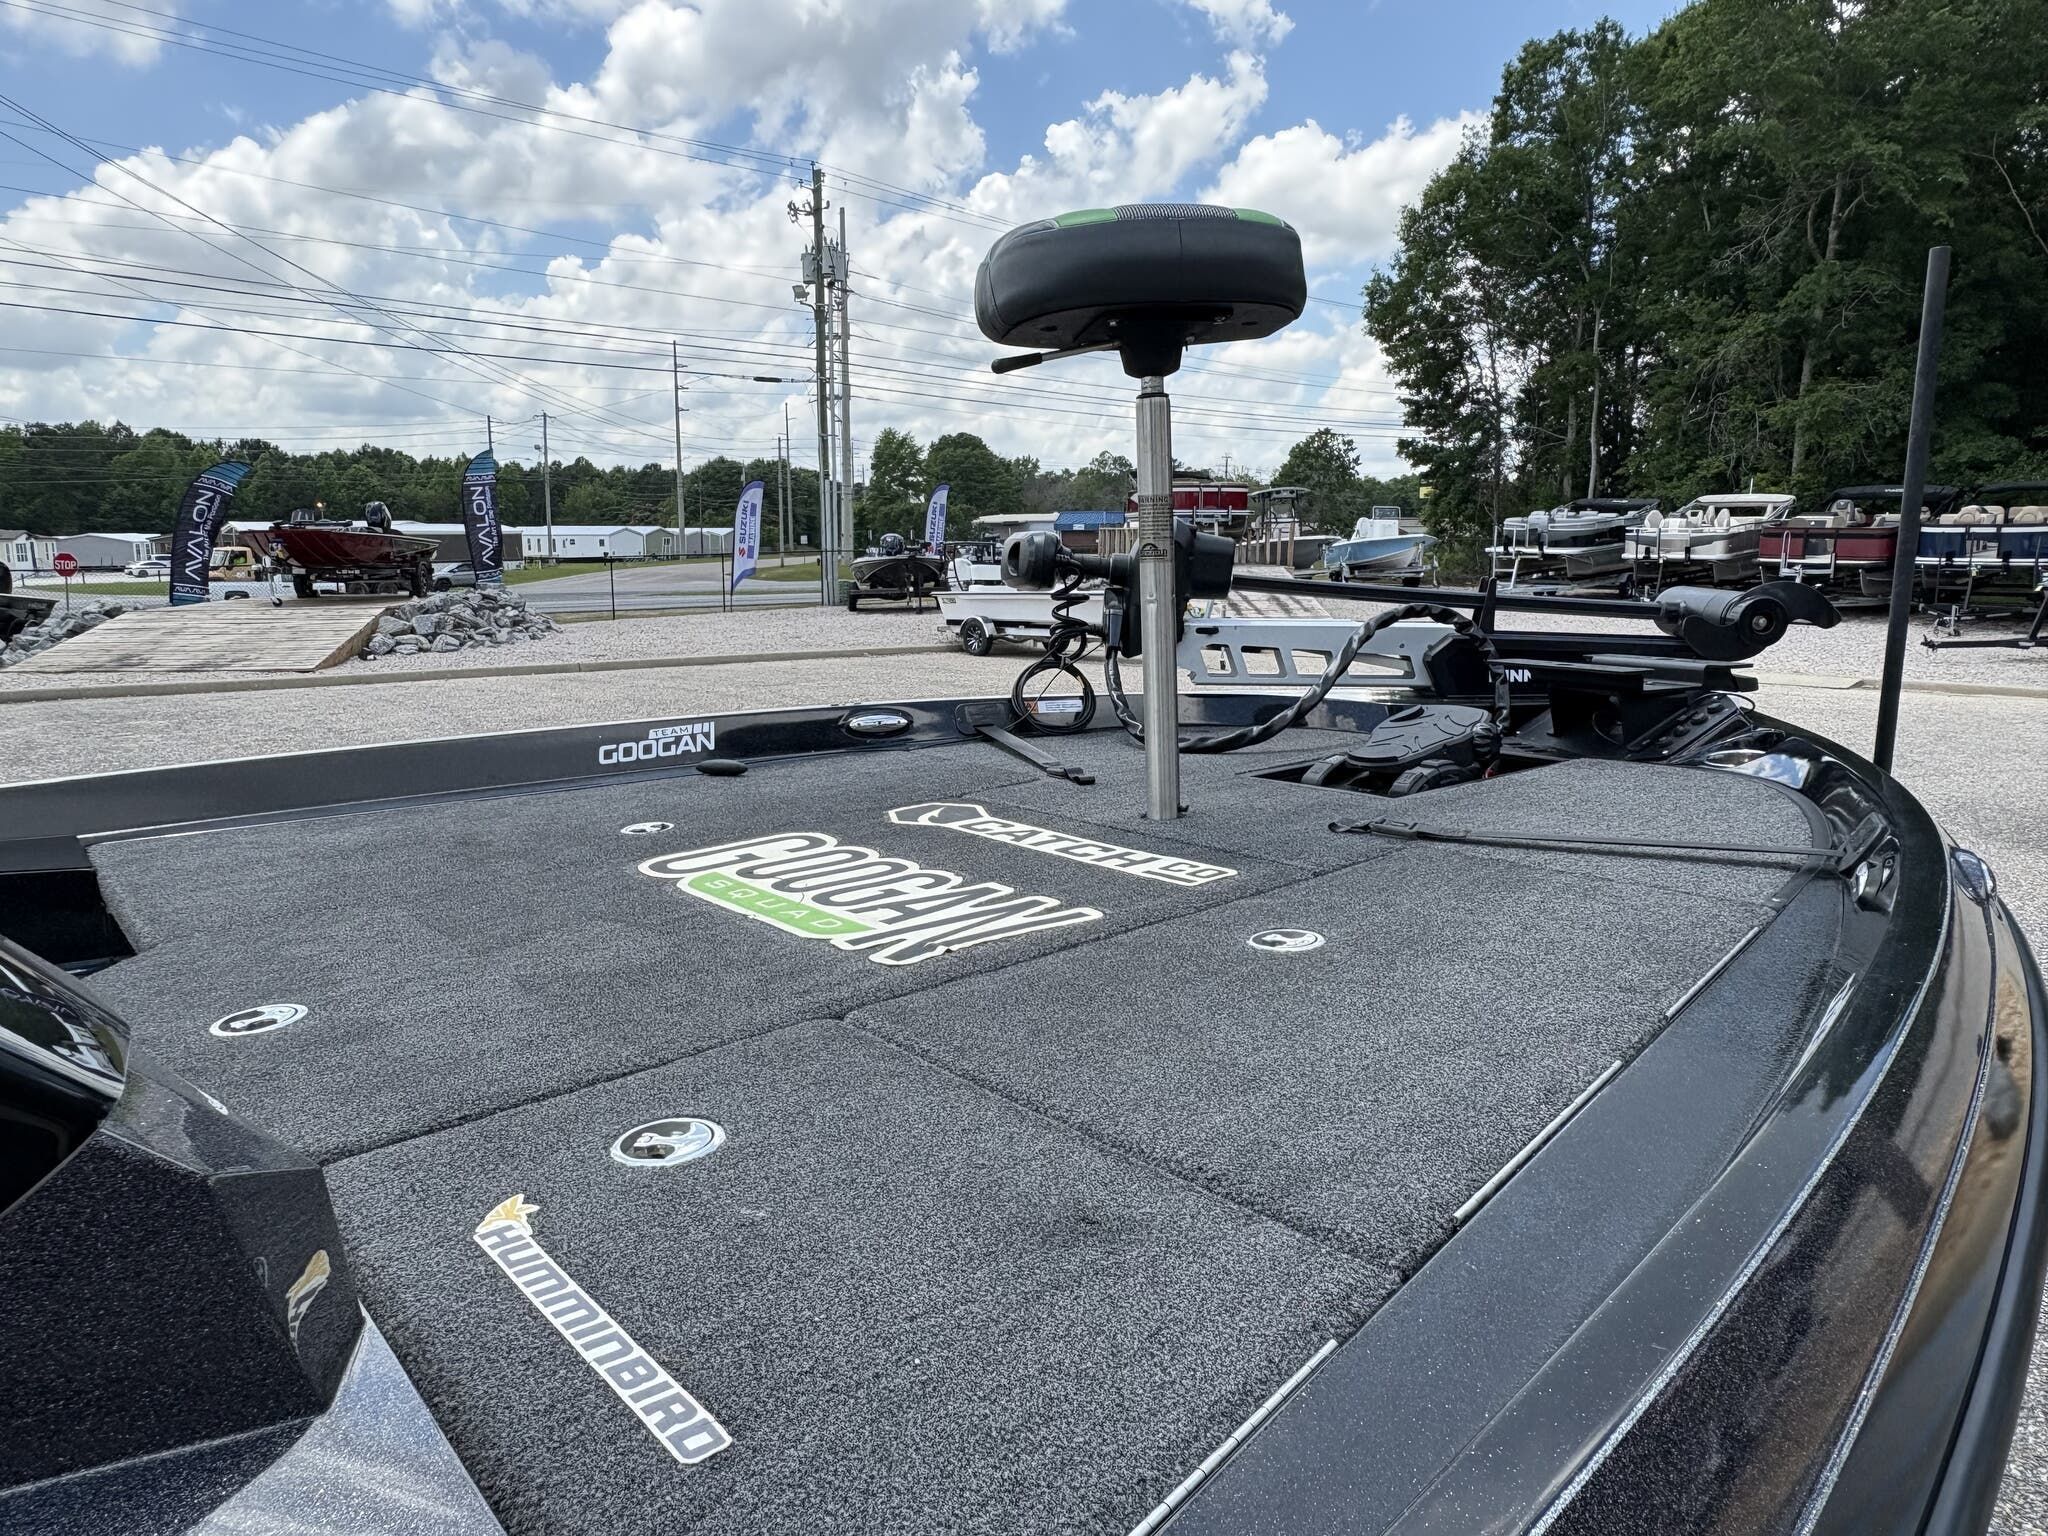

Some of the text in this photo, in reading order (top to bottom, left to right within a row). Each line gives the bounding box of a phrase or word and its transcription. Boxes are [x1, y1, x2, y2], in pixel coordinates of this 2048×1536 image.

[185, 489, 215, 581] AVALON
[470, 486, 495, 566] AVALON
[739, 500, 750, 544] SUZUKI
[929, 501, 938, 542] SUZUKI
[54, 560, 77, 570] STOP
[598, 721, 716, 766] GOOGAN
[653, 726, 690, 737] TEAM
[957, 819, 1231, 880] CATCH CO
[644, 834, 1092, 963] GOOGAN
[704, 879, 843, 929] SQUAD
[477, 1224, 728, 1461] HUMMINBIRD
